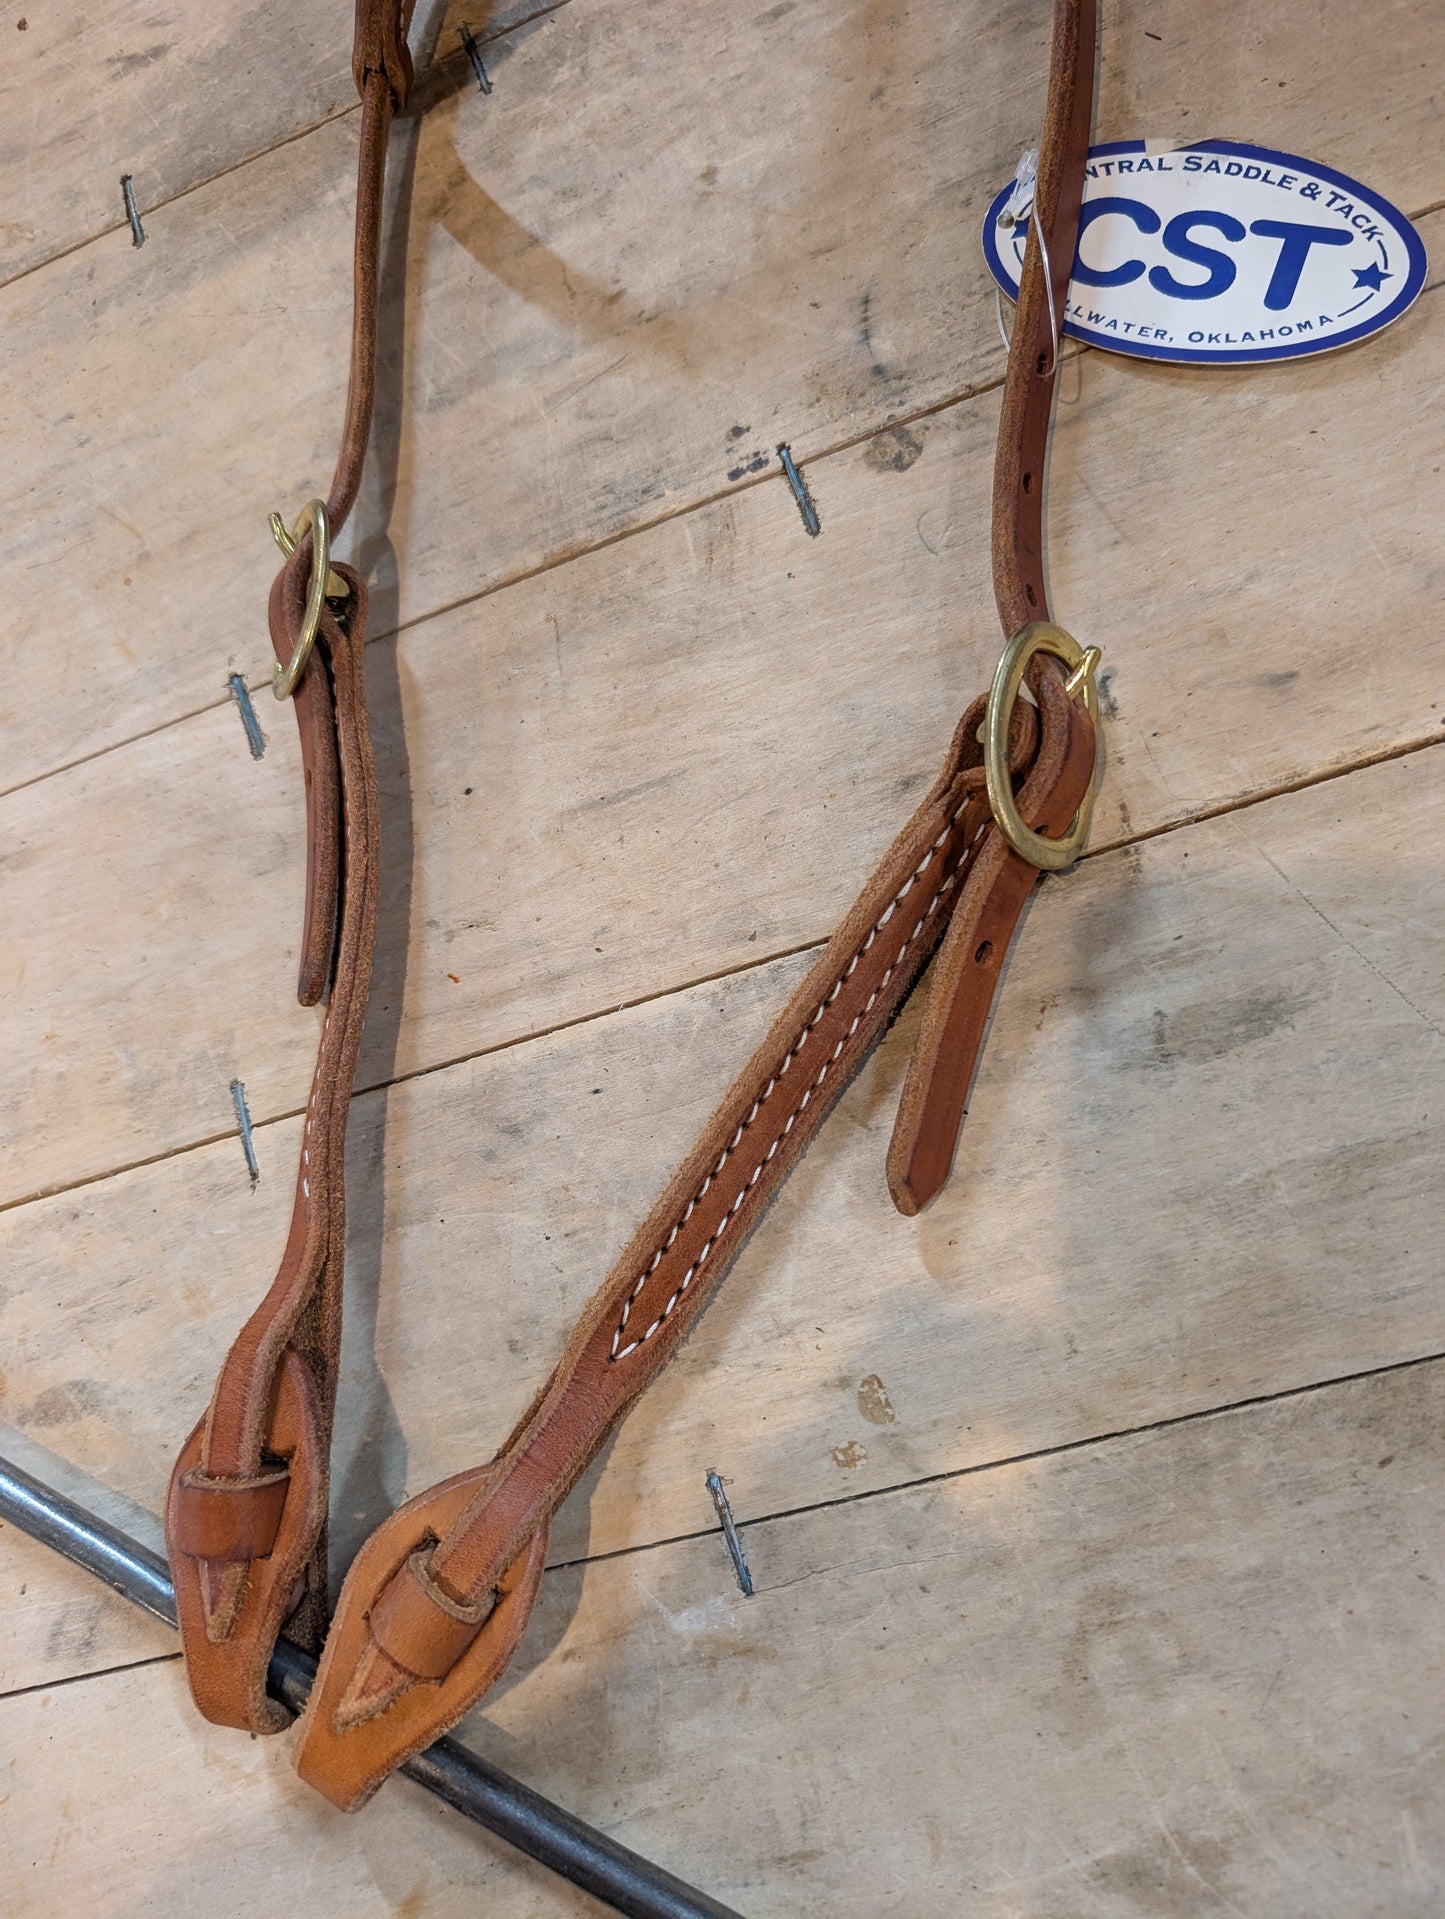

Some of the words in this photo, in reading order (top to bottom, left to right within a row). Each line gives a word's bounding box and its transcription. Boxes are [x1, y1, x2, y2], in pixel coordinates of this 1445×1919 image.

[1085, 157, 1173, 180] NTRAL
[1183, 156, 1298, 190] SADDLE
[1300, 182, 1323, 201] &
[1325, 191, 1384, 242] TACK
[1070, 197, 1354, 311] CST
[1188, 315, 1333, 344] OKLAHOMA
